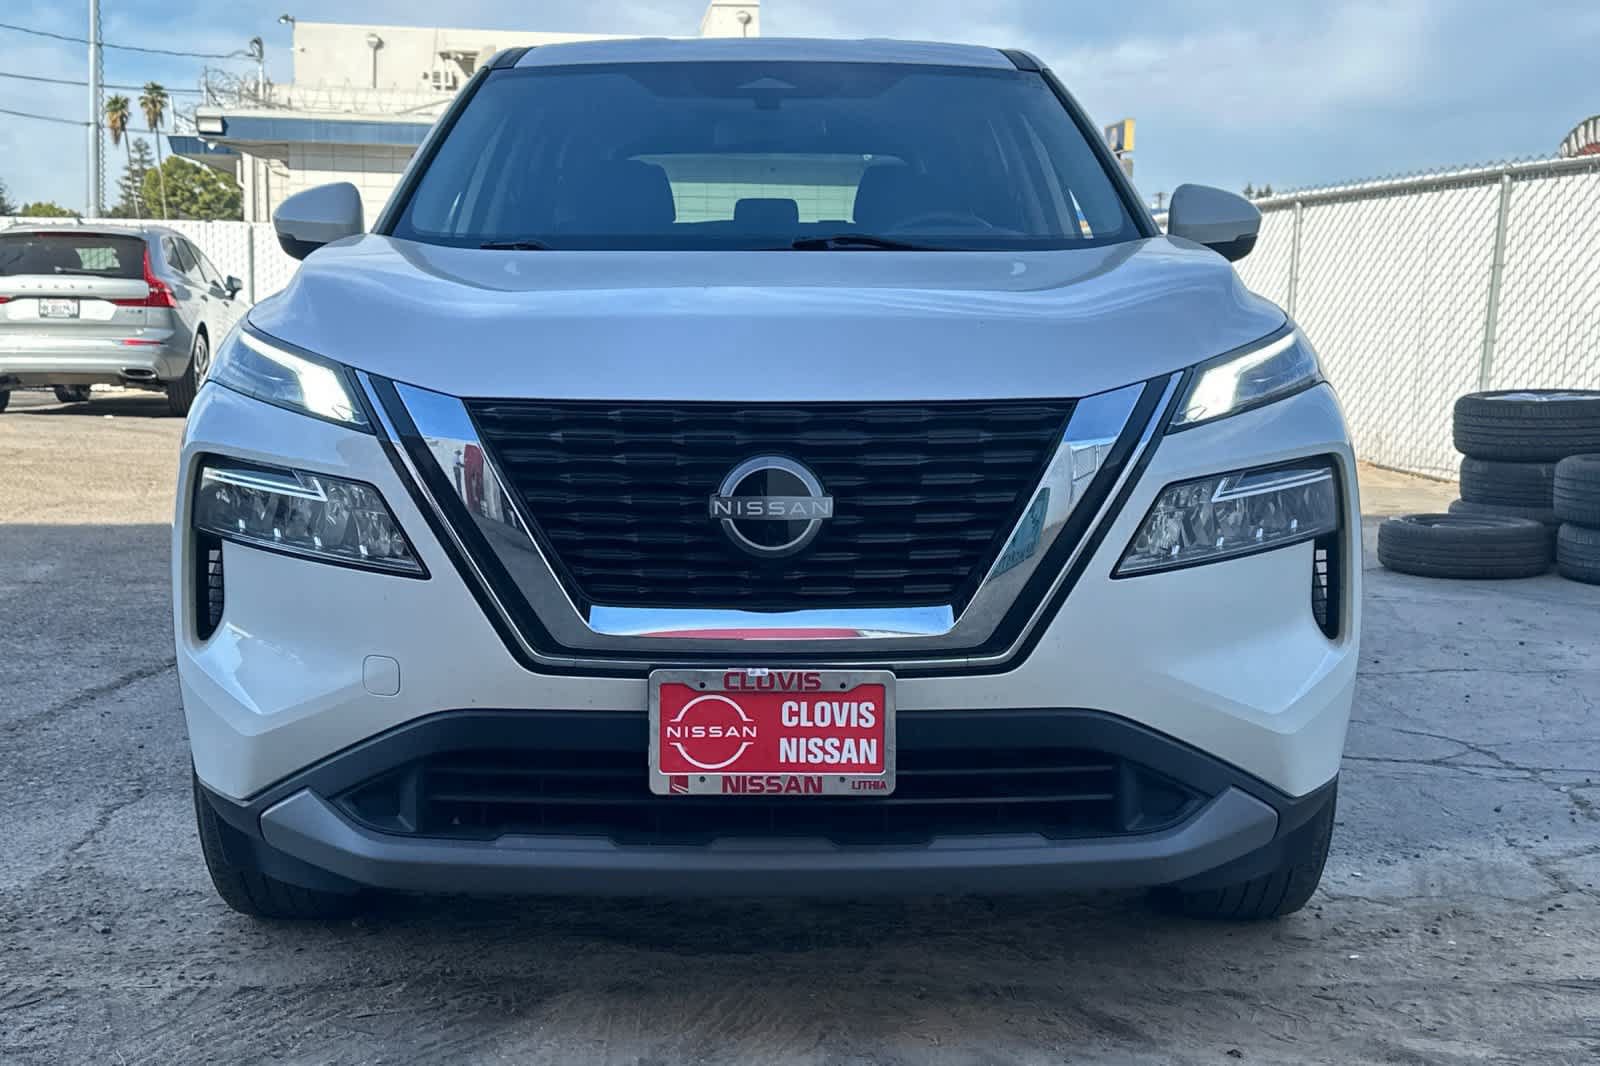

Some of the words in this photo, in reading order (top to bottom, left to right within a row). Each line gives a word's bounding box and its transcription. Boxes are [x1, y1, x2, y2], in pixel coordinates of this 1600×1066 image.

[714, 501, 829, 515] NISSAN
[723, 672, 822, 690] CLOVIS
[781, 701, 875, 727] CLOVIS
[666, 726, 757, 738] NISSAN
[779, 738, 877, 764] NISSAN
[722, 776, 823, 793] NISSAN
[851, 780, 887, 790] LITHIA
